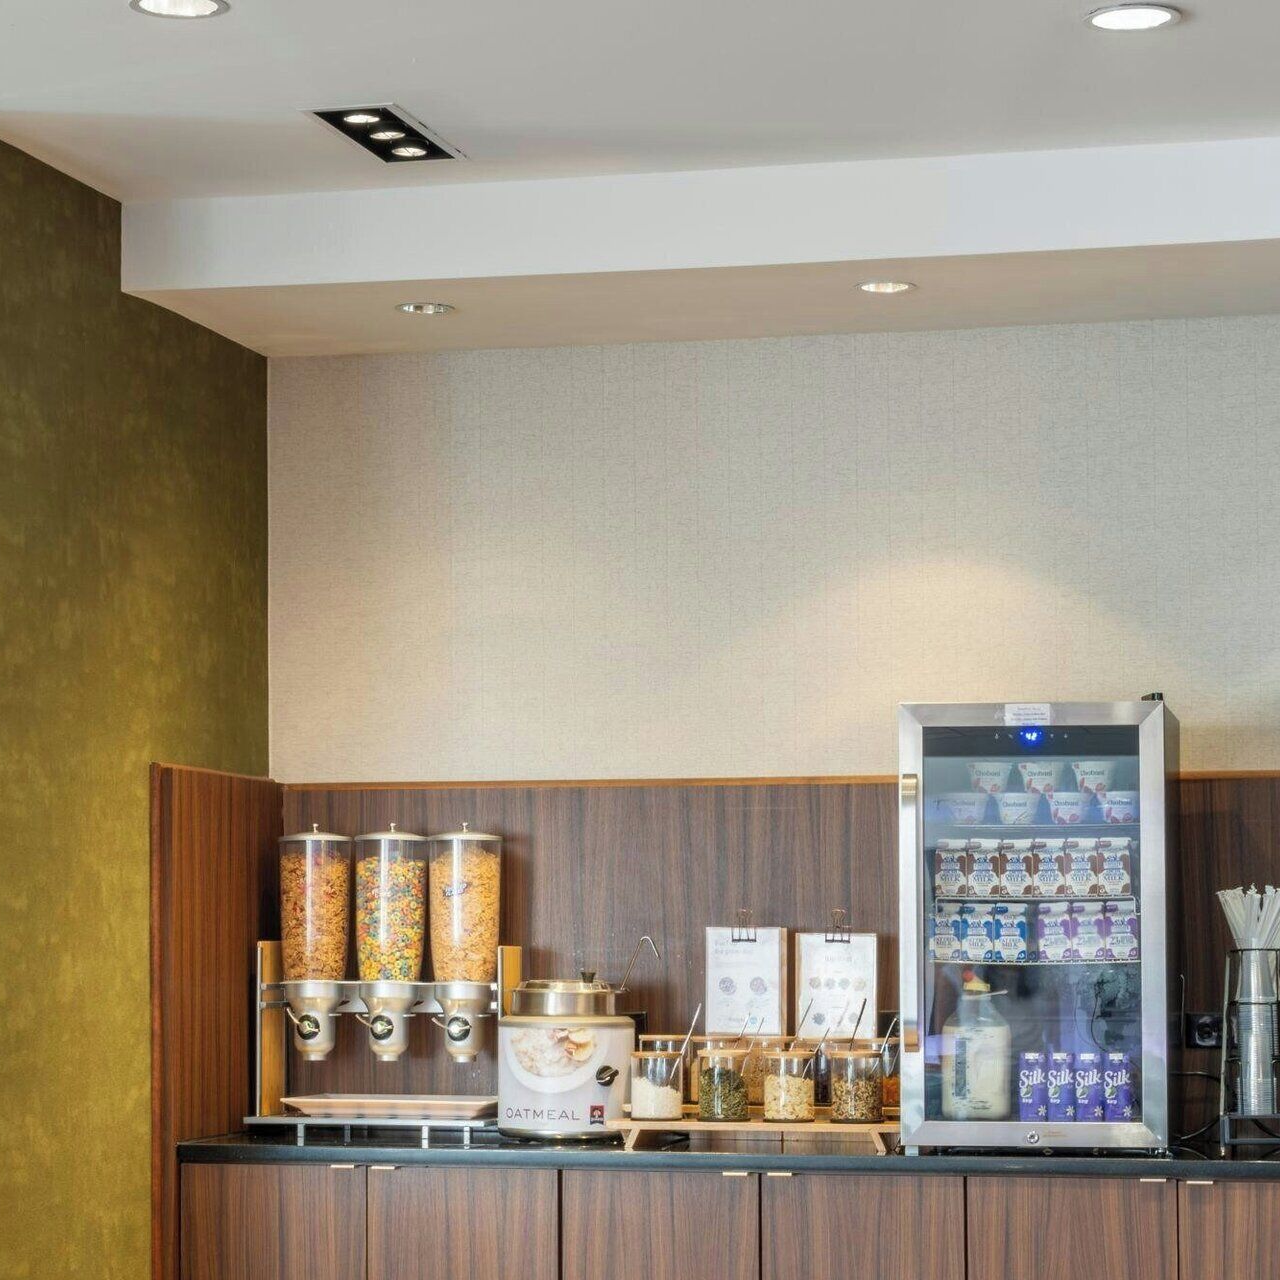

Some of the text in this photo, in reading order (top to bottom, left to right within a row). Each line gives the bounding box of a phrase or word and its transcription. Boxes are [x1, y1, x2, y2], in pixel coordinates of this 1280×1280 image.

[1019, 1068, 1046, 1089] Silk
[1047, 1068, 1074, 1089] Silk
[1075, 1068, 1102, 1089] Silk
[1103, 1069, 1131, 1090] Silk
[505, 1107, 580, 1121] OATMEAL
